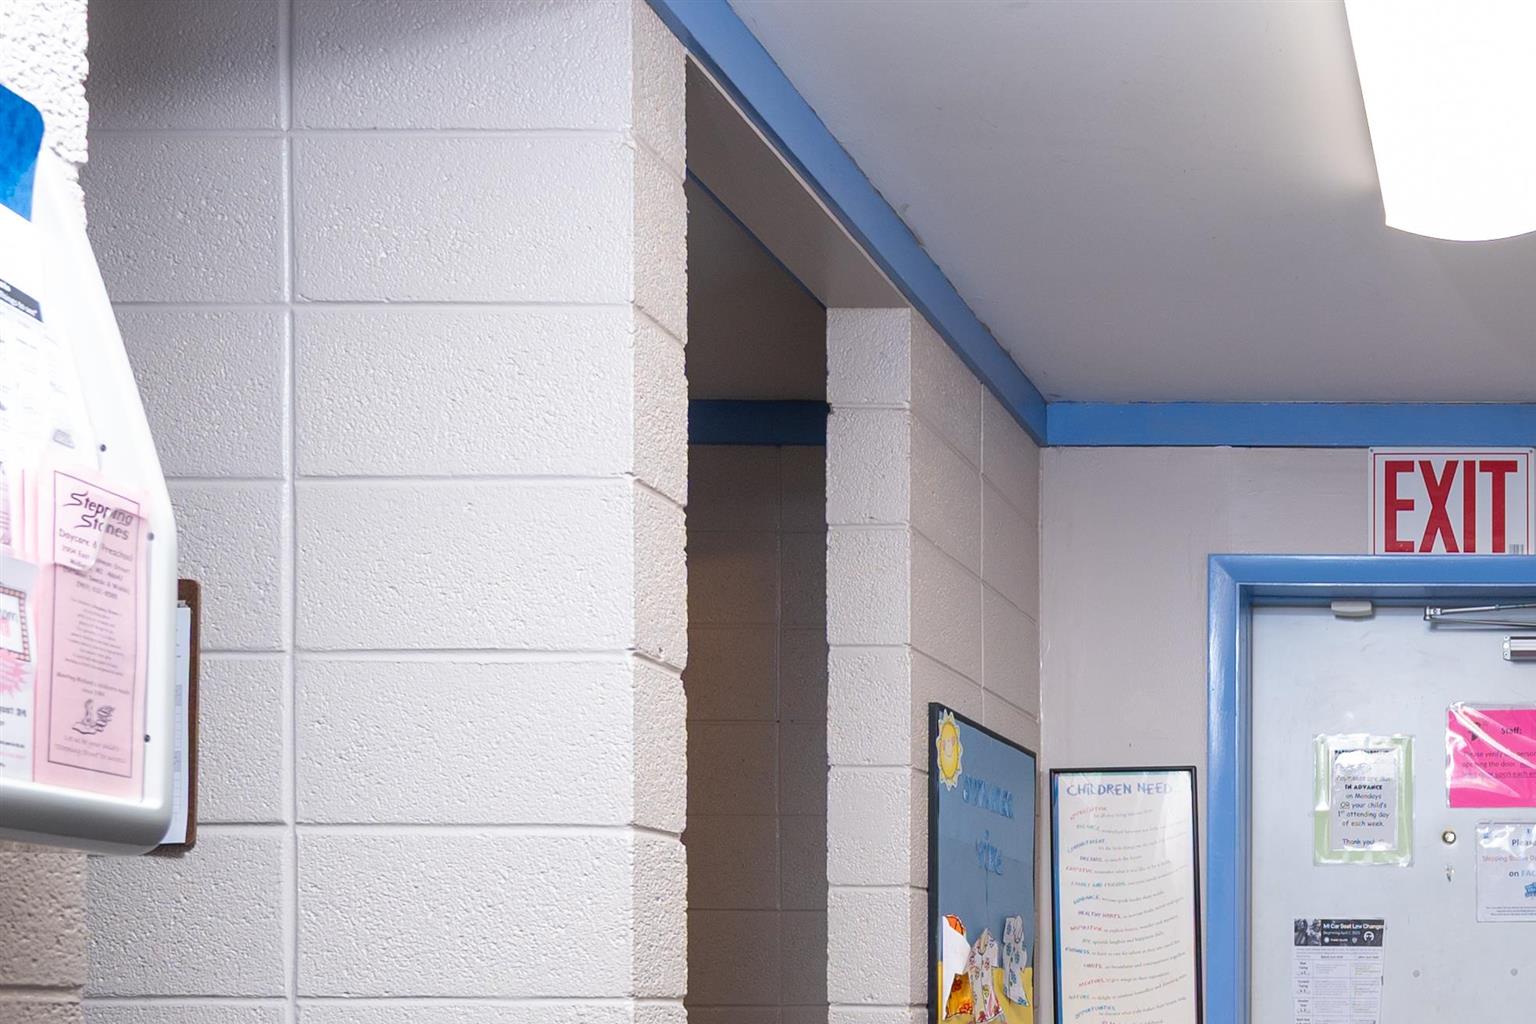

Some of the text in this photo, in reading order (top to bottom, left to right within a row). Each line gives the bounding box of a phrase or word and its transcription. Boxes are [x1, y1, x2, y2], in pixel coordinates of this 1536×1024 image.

[1384, 460, 1518, 553] EXIT
[1501, 726, 1522, 735] Staff:
[1066, 782, 1132, 796] CHILDREN
